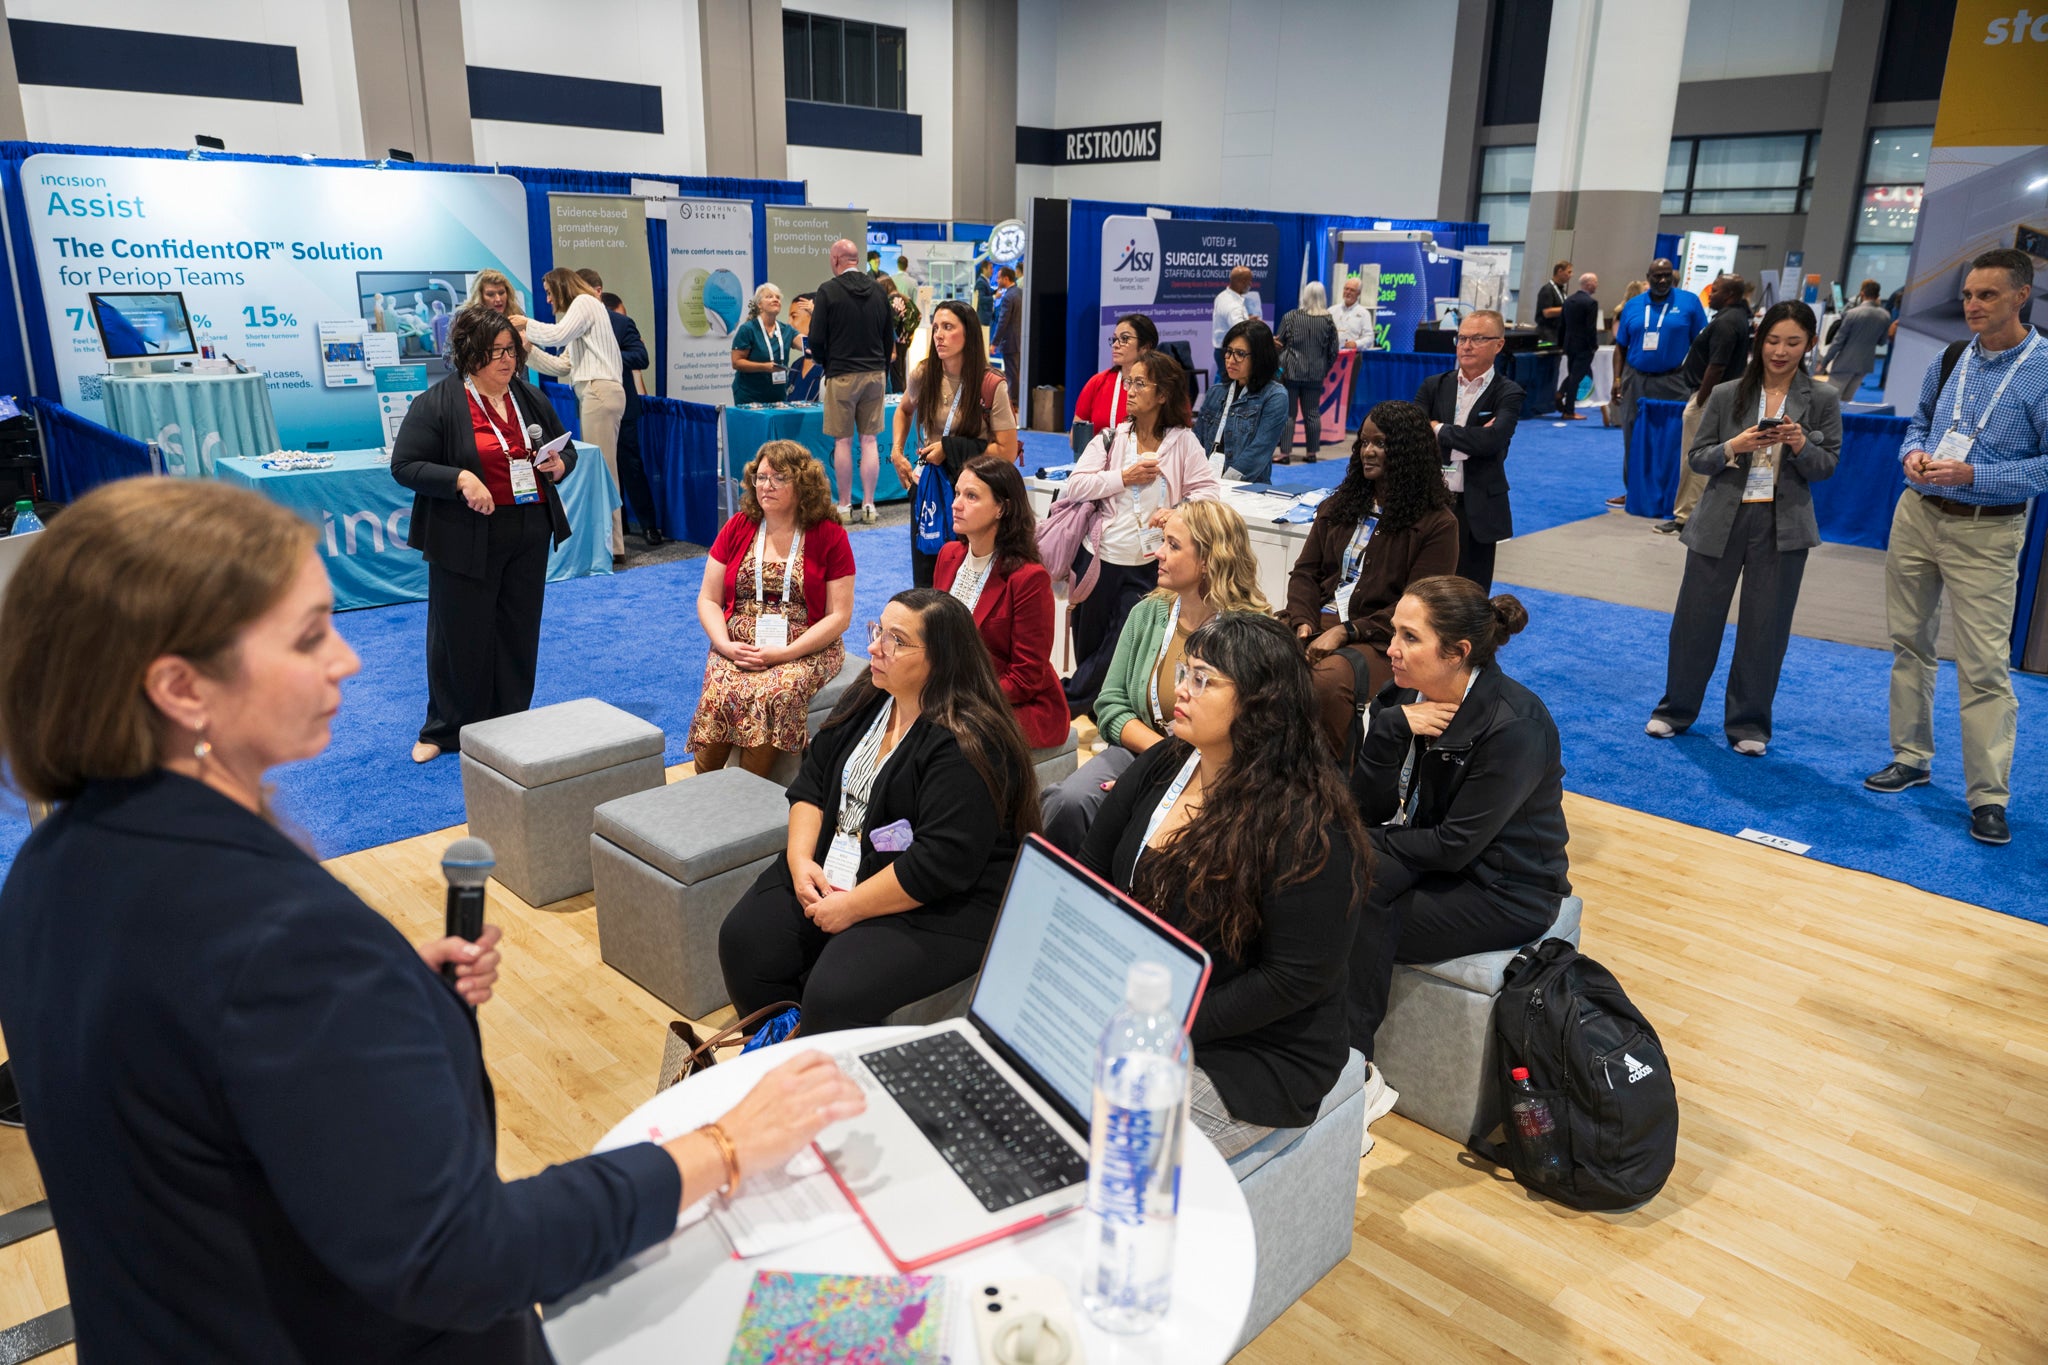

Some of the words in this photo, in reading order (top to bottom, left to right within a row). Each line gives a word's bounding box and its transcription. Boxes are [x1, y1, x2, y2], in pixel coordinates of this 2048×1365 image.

[1066, 128, 1156, 160] RESTROOMS
[40, 174, 107, 188] incision
[48, 191, 146, 218] Assist
[695, 204, 737, 213] SOOTHING
[556, 206, 628, 219] Evidence-based
[558, 223, 619, 235] aromatherapy
[772, 217, 790, 227] The
[792, 218, 829, 229] comfort
[558, 236, 571, 247] for
[573, 236, 605, 250] patient
[606, 239, 628, 248] care.
[773, 232, 821, 242] promotion
[824, 232, 842, 241] tool
[1202, 236, 1226, 248] VOTED
[1227, 237, 1238, 248] #1
[52, 237, 104, 258] The
[291, 241, 383, 260] Solution
[773, 245, 807, 254] trusted
[808, 245, 820, 257] by
[1165, 252, 1219, 267] SURGICAL
[1220, 253, 1269, 267] SERVICES
[59, 265, 92, 286] for
[98, 266, 172, 290] Periop
[174, 267, 245, 285] Teams
[1164, 269, 1194, 279] STAFFING
[1196, 270, 1202, 279] &
[1203, 270, 1231, 279] CONSULTI
[1379, 273, 1418, 288] veryone,
[242, 305, 298, 328] 15%
[245, 333, 271, 341] Shorter
[273, 369, 304, 380] cases,
[282, 380, 314, 390] needs.
[1628, 1064, 1654, 1084] adidas
